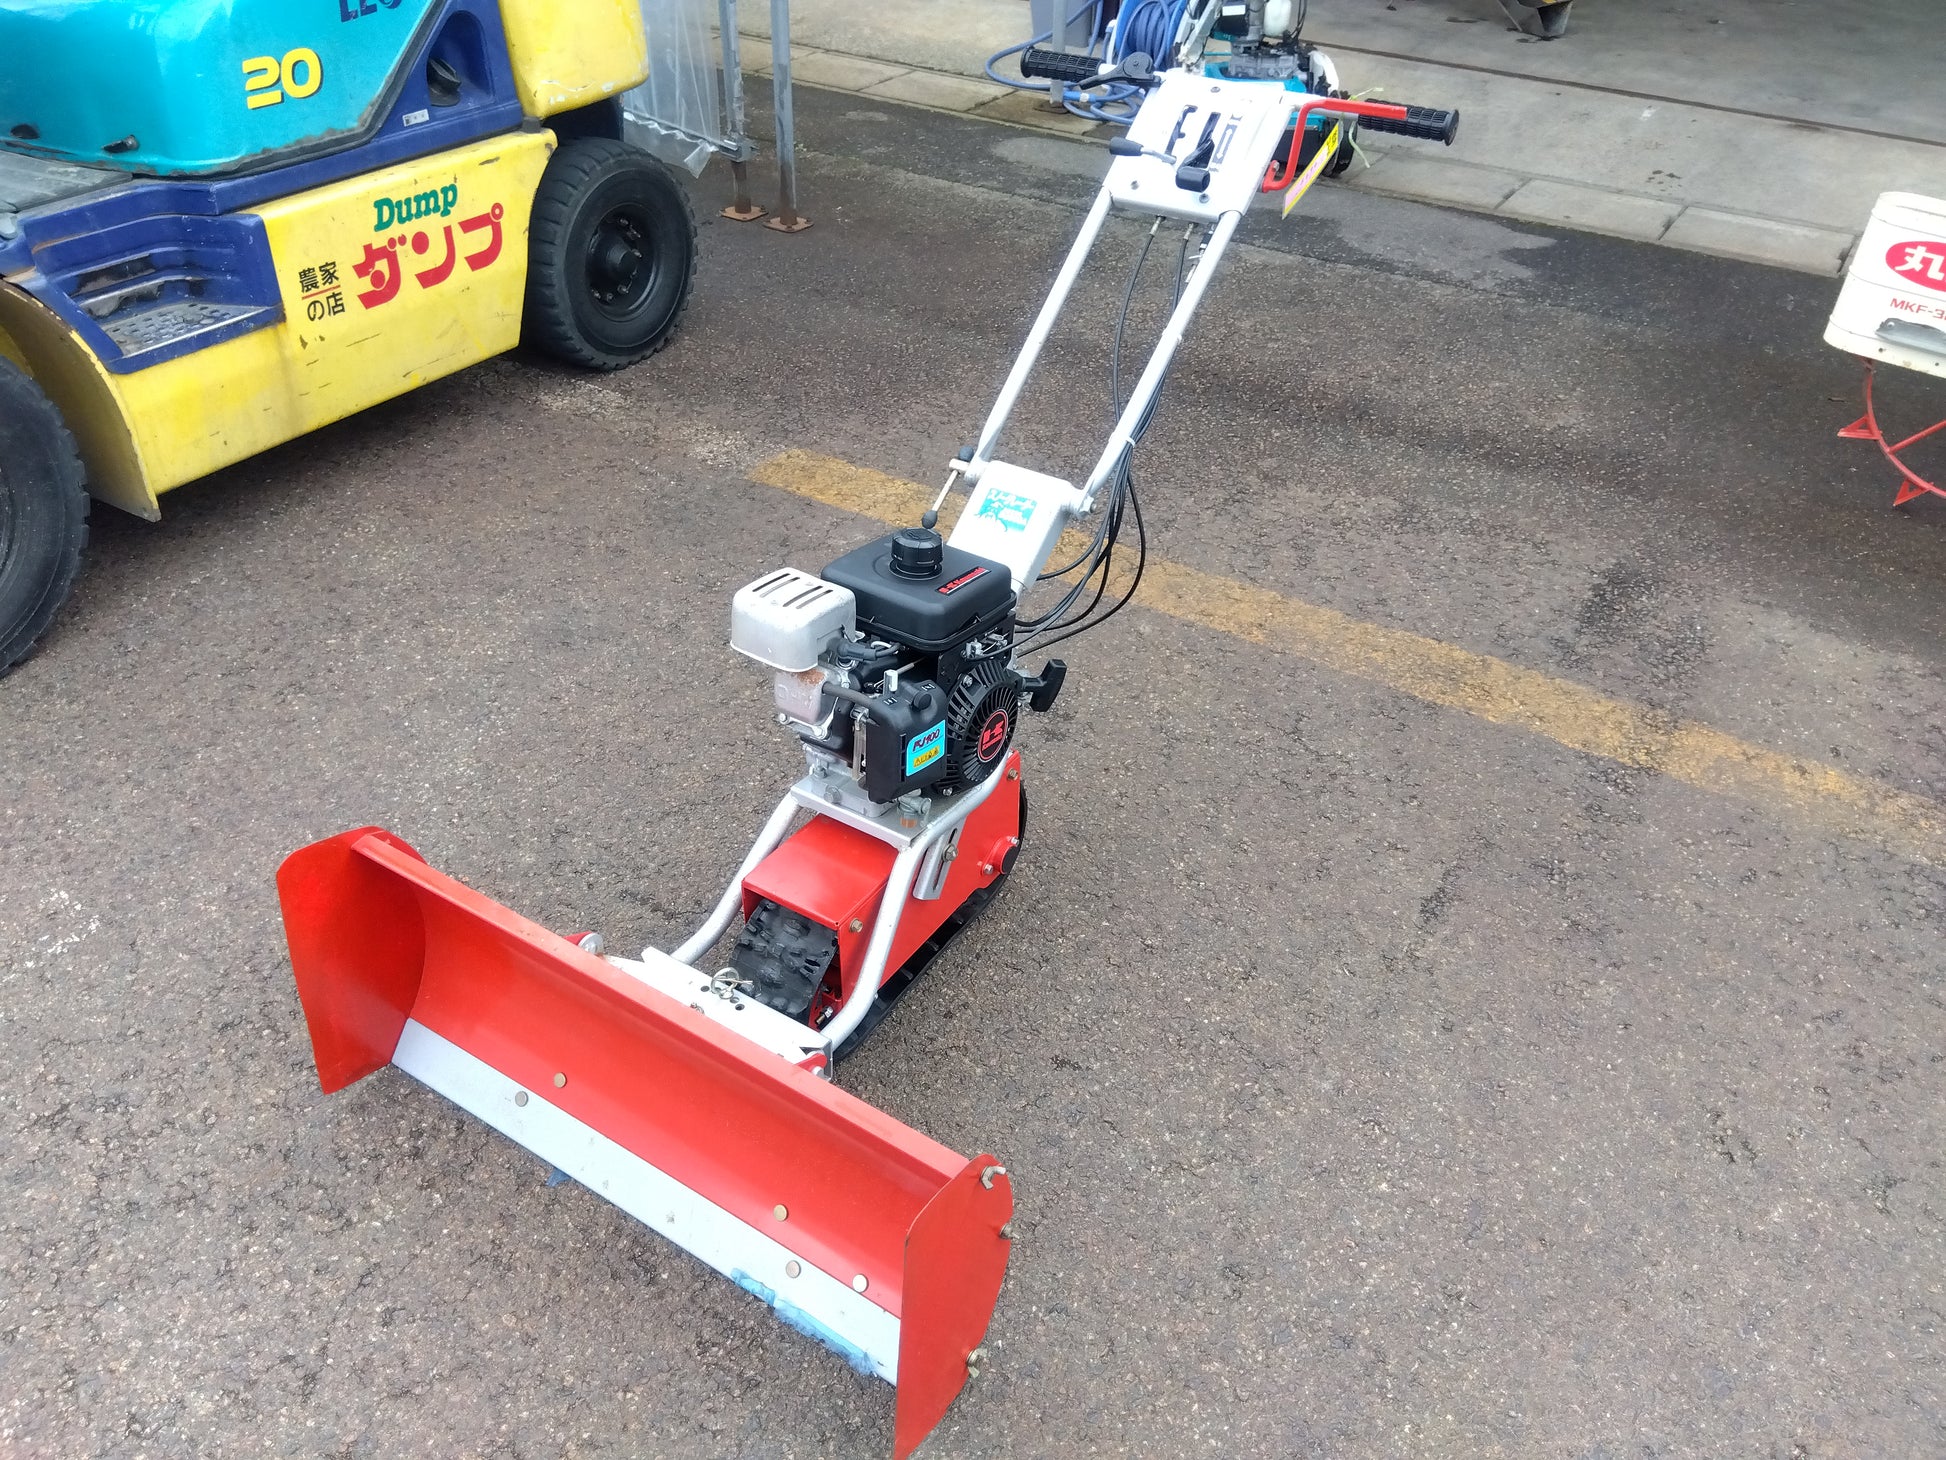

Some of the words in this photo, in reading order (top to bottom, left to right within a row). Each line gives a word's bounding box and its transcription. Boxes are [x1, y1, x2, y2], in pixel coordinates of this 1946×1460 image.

[242, 47, 323, 110] 20
[373, 183, 458, 232] Dump
[352, 202, 504, 310] ダンプ
[1894, 245, 1945, 281] 丸
[298, 261, 340, 293] 農家
[306, 291, 346, 322] の店
[1889, 298, 1946, 320] MKF-3
